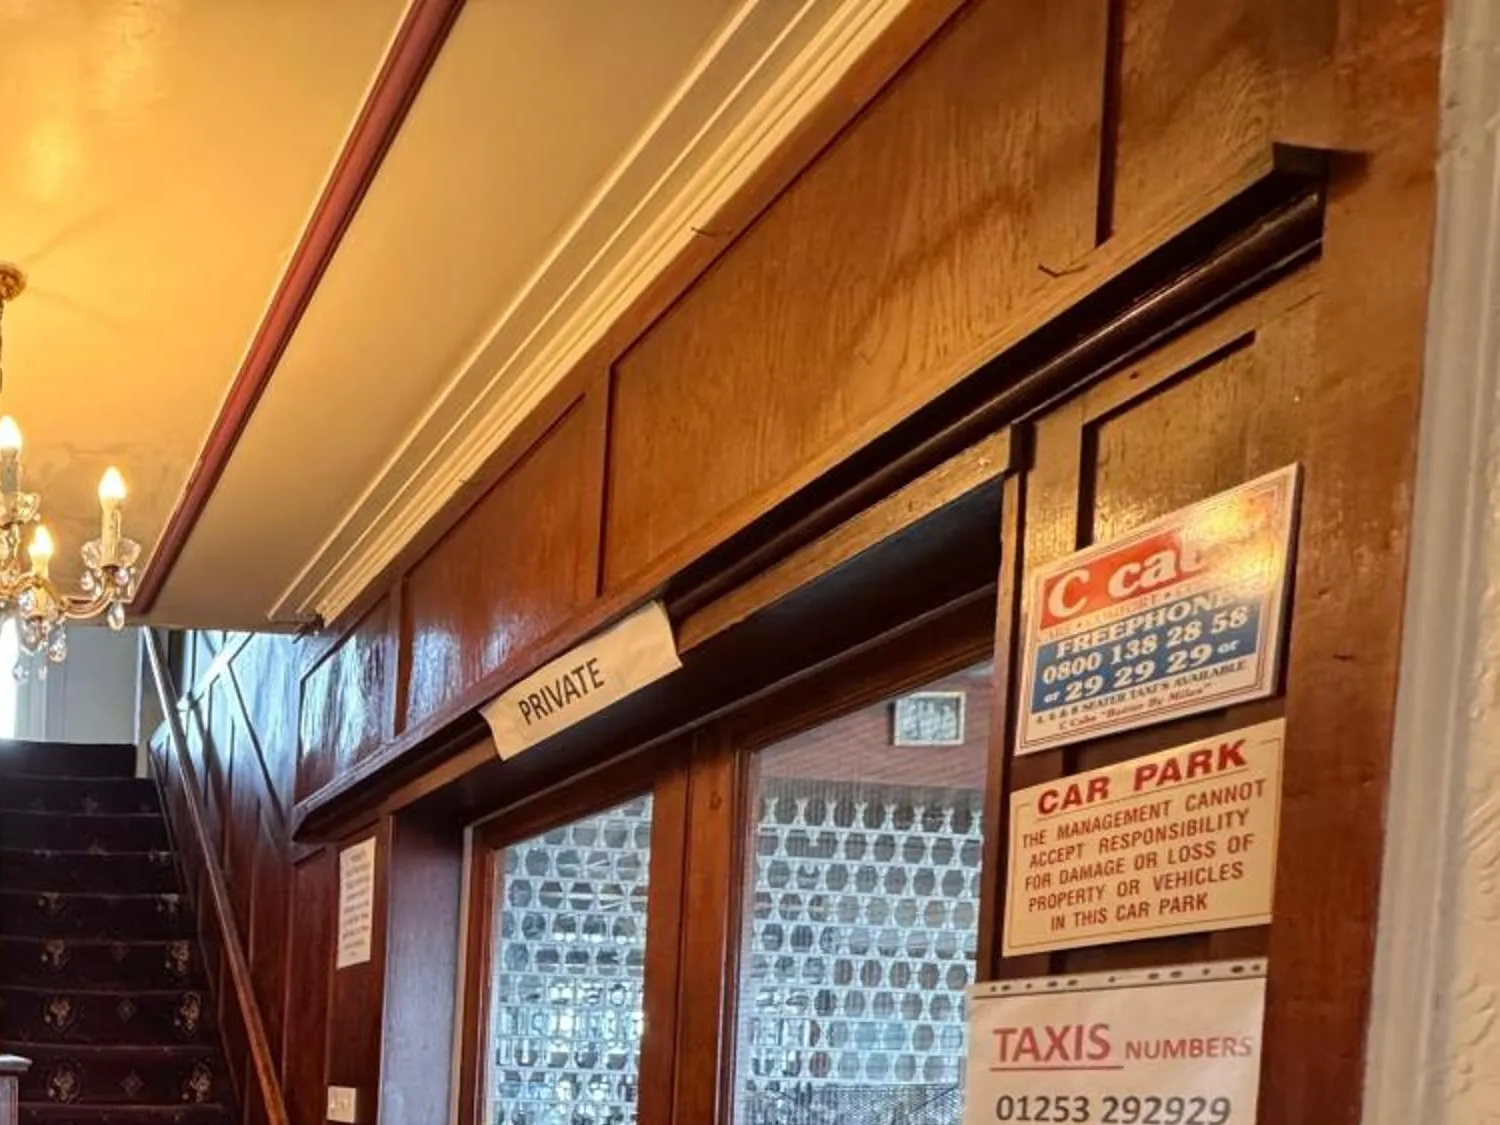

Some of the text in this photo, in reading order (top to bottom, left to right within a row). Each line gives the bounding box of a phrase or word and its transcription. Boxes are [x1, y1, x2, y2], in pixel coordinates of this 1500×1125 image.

[1050, 568, 1089, 617] C
[1043, 652, 1102, 684] 0800
[1111, 635, 1158, 665] 138
[1167, 620, 1202, 648] 28
[1211, 606, 1248, 635] 58
[1066, 675, 1104, 702] 29
[1114, 660, 1156, 688] 29
[1167, 643, 1212, 673] 29
[517, 657, 605, 726] PRIVATE
[1037, 739, 1247, 816] CAR PARK
[1022, 779, 1267, 849] THE MANAGEMENT CANNOT
[1029, 808, 1251, 869] ACCEPT RESPONSIBILITY
[1025, 834, 1255, 892] FOR DAMAGE OR LOSS OF
[1028, 861, 1245, 913] PROPERTY OR VEHICLES
[1050, 893, 1209, 932] IN THIS CAR PARK
[993, 1022, 1254, 1063] TAXIS NUMBERS
[996, 1095, 1090, 1123] 01253
